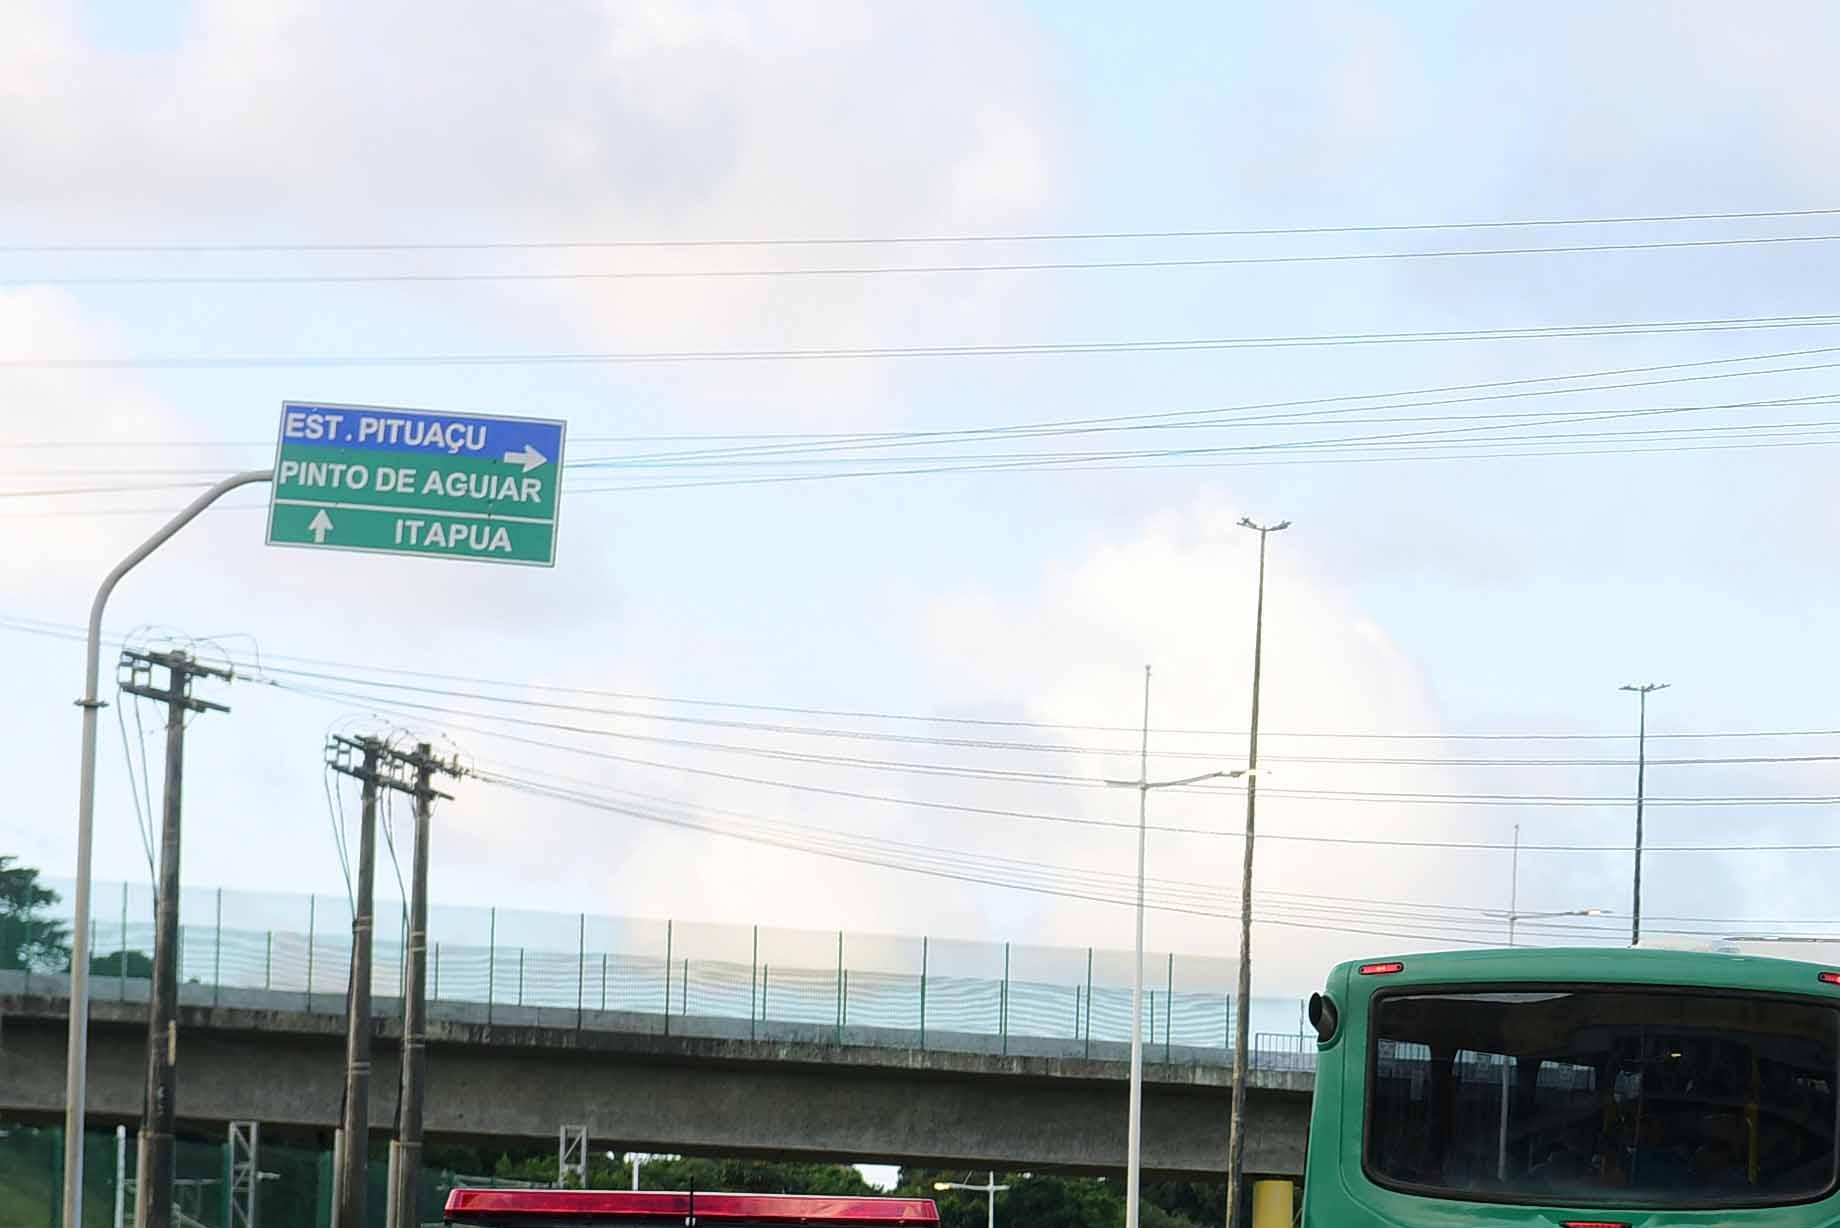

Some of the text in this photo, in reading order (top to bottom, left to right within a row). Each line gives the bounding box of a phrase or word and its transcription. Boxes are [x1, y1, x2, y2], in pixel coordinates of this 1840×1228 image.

[285, 412, 488, 455] EST. PITUAÇU
[279, 461, 543, 503] PINTO DE AGUIAR
[394, 519, 513, 552] ITAPUA
